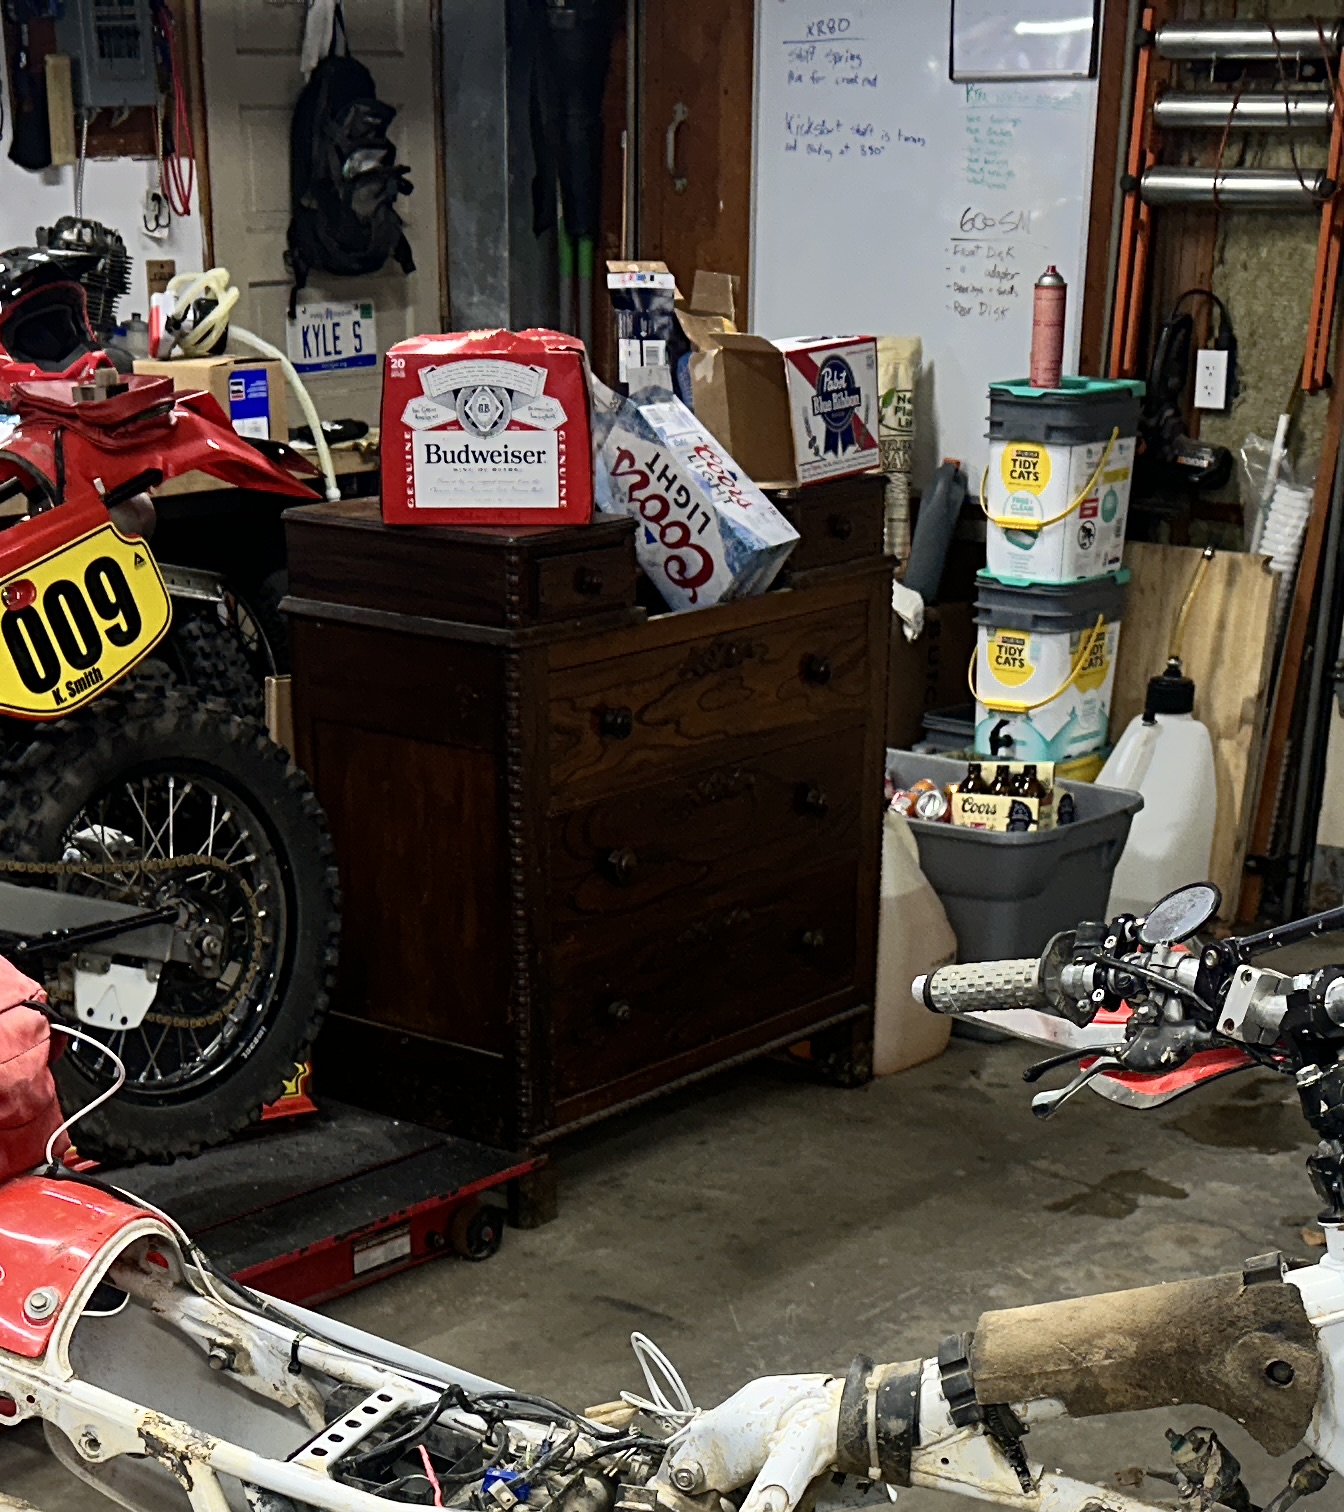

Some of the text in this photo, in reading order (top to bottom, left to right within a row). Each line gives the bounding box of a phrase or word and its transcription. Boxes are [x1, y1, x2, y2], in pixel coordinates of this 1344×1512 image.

[301, 320, 363, 359] KYLE S
[390, 357, 406, 369] 20
[821, 367, 847, 392] Pabst
[404, 431, 415, 508] GENUINE
[424, 443, 547, 464] Budweiser
[558, 430, 567, 508] GENUINE
[1011, 458, 1039, 471] TIDY
[645, 451, 711, 535] LIGHT
[687, 454, 737, 505] LIGHT
[694, 443, 753, 509] Coors
[1009, 470, 1040, 482] CATS
[611, 446, 714, 603] Coors
[1, 556, 142, 694] 009
[995, 657, 1025, 669] CATS
[996, 644, 1024, 657] TIDY
[51, 667, 104, 707] K. Smith
[961, 796, 997, 815] Coors
